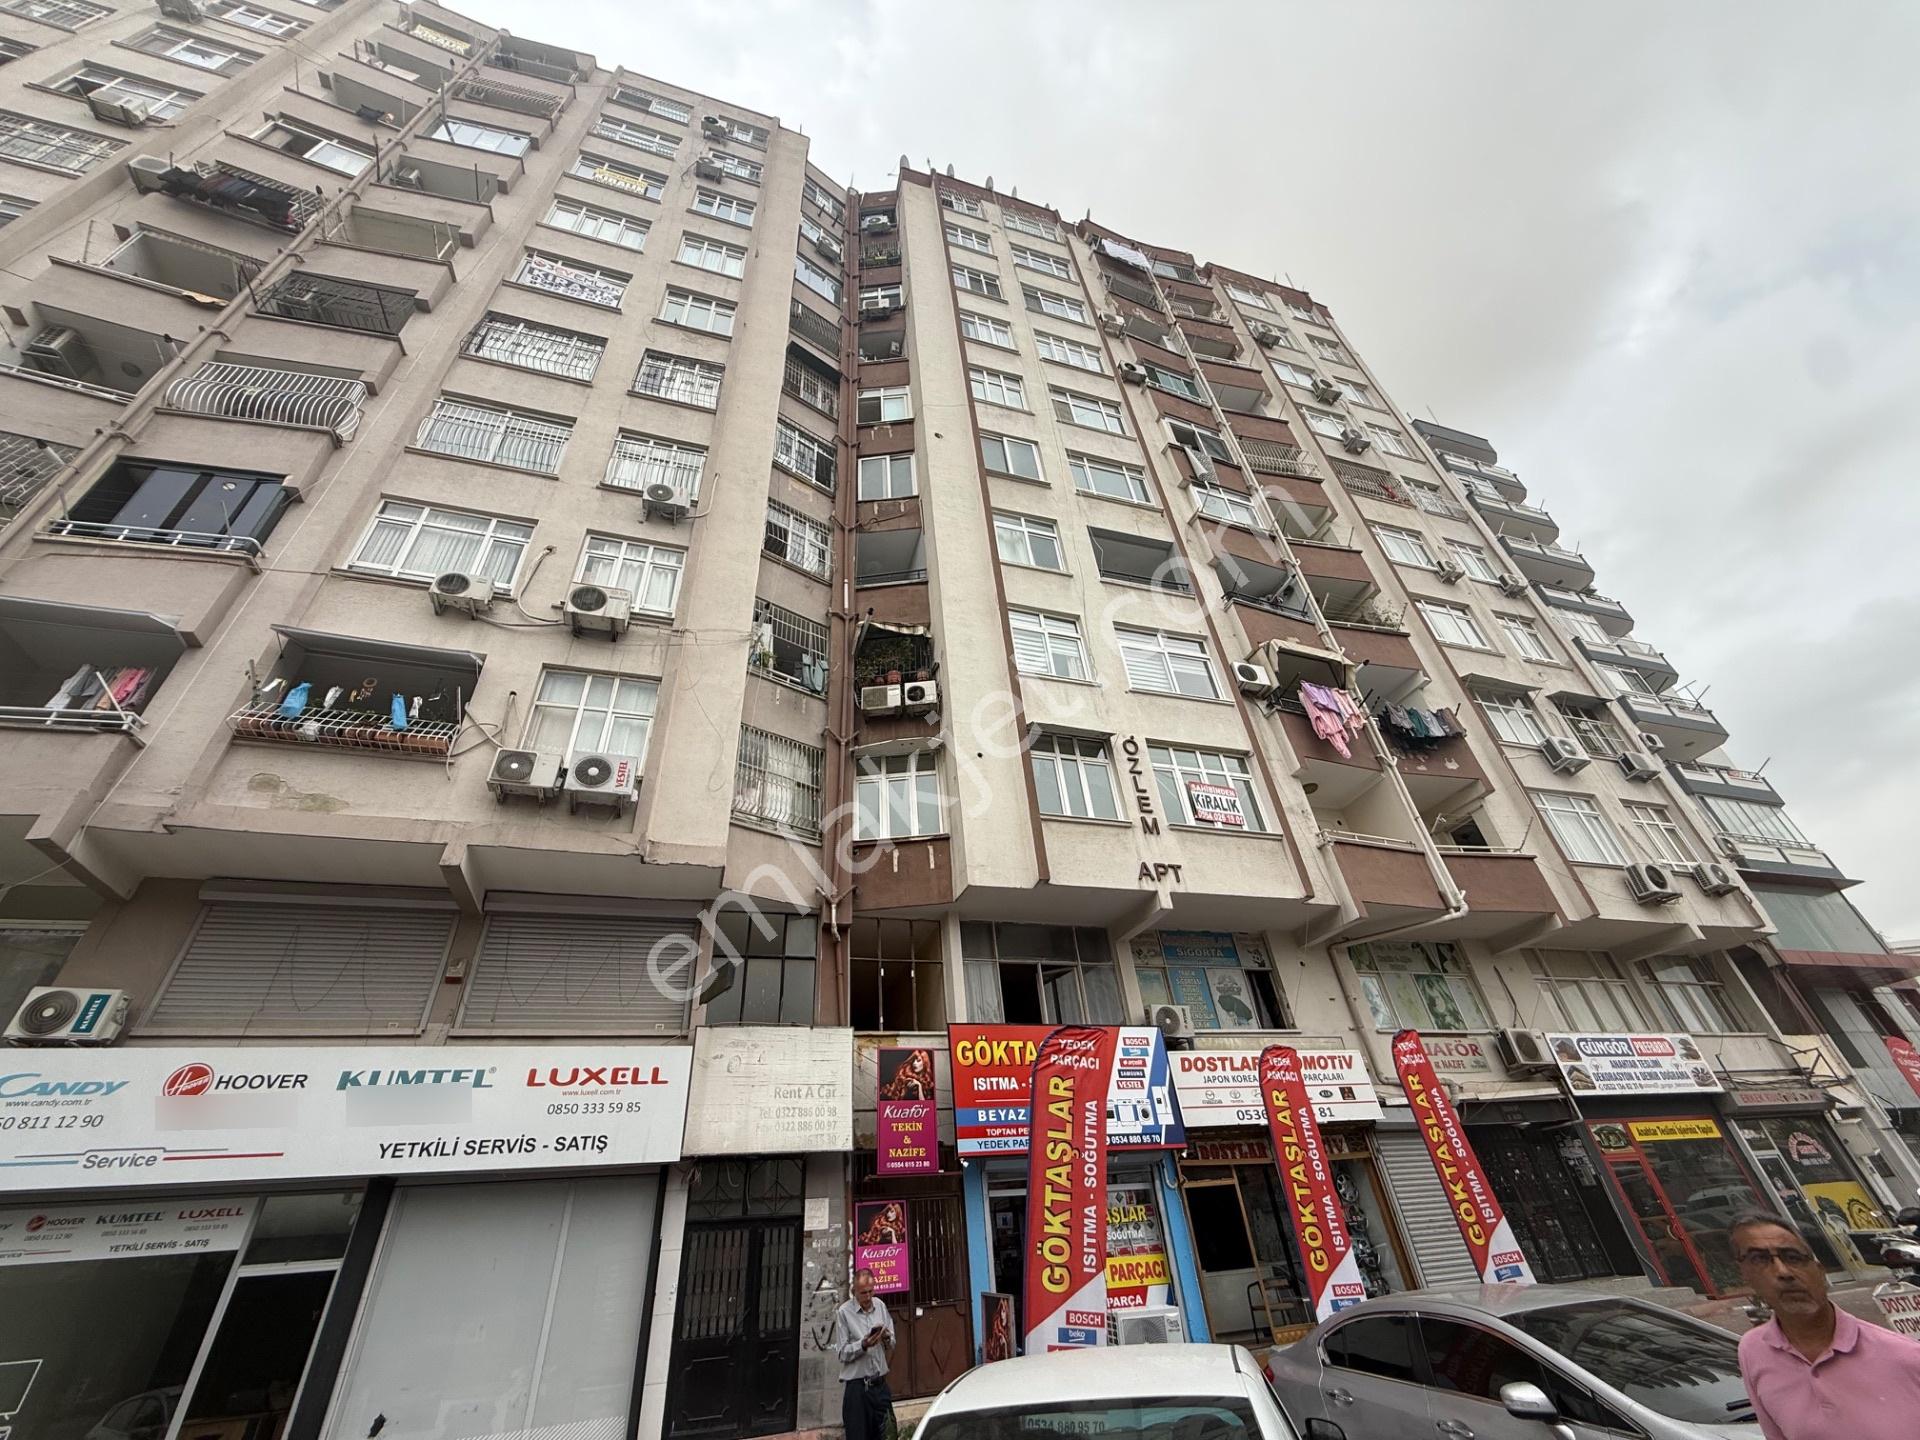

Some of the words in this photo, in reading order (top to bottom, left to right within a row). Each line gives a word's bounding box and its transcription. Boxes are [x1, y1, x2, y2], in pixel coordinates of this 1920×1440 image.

[615, 760, 629, 788] VESTEL
[1122, 735, 1161, 836] ÖZLEM
[1138, 861, 1182, 884] APT
[1058, 1038, 1095, 1051] YEDEK
[1124, 1038, 1148, 1046] BOSCH
[1579, 1037, 1632, 1056] GÜNGÖR
[956, 1036, 1038, 1066] GÖKTA
[1050, 1053, 1100, 1070] PARÇACI
[214, 1074, 308, 1090] HOOVER
[526, 1066, 669, 1087] LUXELL
[973, 1076, 1019, 1092] ISITMA
[1203, 1075, 1231, 1085] JAPON
[1304, 1073, 1345, 1083] PARÇALARI
[0, 1073, 130, 1098] CANDY
[773, 1085, 802, 1100] Rent
[804, 1084, 814, 1099] A
[817, 1083, 837, 1099] Car
[1118, 1080, 1143, 1089] VESTEL
[5, 1099, 92, 1108] www.candy.com.tr
[547, 1103, 579, 1116] 0850
[582, 1102, 605, 1115] 333
[608, 1102, 623, 1114] 59
[626, 1101, 641, 1113] 85
[883, 1104, 930, 1119] Kuaför
[977, 1108, 1027, 1122] BEYAZ
[1318, 1107, 1335, 1118] 81
[17, 1115, 51, 1130] 811
[54, 1115, 78, 1129] 12
[80, 1114, 104, 1128] 90
[891, 1122, 923, 1132] TEKİN
[1431, 1087, 1467, 1158] SOĞUTMA
[986, 1128, 1016, 1137] TOPTAN
[1111, 1135, 1128, 1144] 0534
[1142, 1135, 1151, 1143] 95
[1152, 1134, 1161, 1143] 70
[378, 1137, 460, 1160] YETKİLİ
[463, 1133, 536, 1156] SERVİS
[554, 1134, 609, 1155] SATIŞ
[903, 1136, 912, 1145] &
[976, 1139, 1011, 1150] YEDEK
[1081, 1100, 1098, 1188] SOĞUTMA
[1298, 1106, 1326, 1182] SOĞUTMA
[889, 1147, 927, 1158] NAZİFE
[1407, 1072, 1486, 1246] GÖKTAŞLAR
[82, 1153, 158, 1170] Service
[1036, 1076, 1080, 1294] GÖKTAŞLAR
[1271, 1089, 1329, 1273] GÖKTAŞLAR
[1465, 1171, 1497, 1224] ISITMA
[96, 1211, 164, 1225] KUMTEL
[176, 1207, 244, 1220] LUXELL
[47, 1217, 87, 1226] HOOVER
[1322, 1194, 1347, 1252] ISITMA
[109, 1240, 145, 1253] YETKİLİ
[145, 1238, 177, 1251] SERVİS
[184, 1238, 210, 1248] SATIŞ
[1083, 1205, 1097, 1274] ISITMA
[861, 1246, 902, 1259] Kuaför
[1493, 1252, 1520, 1266] BOSCH
[873, 1274, 899, 1284] AZİFE
[1109, 1260, 1168, 1284] PARÇACI
[1334, 1284, 1362, 1296] BOSCH
[1068, 1312, 1102, 1325] BOSCH
[1068, 1329, 1086, 1338] beko
